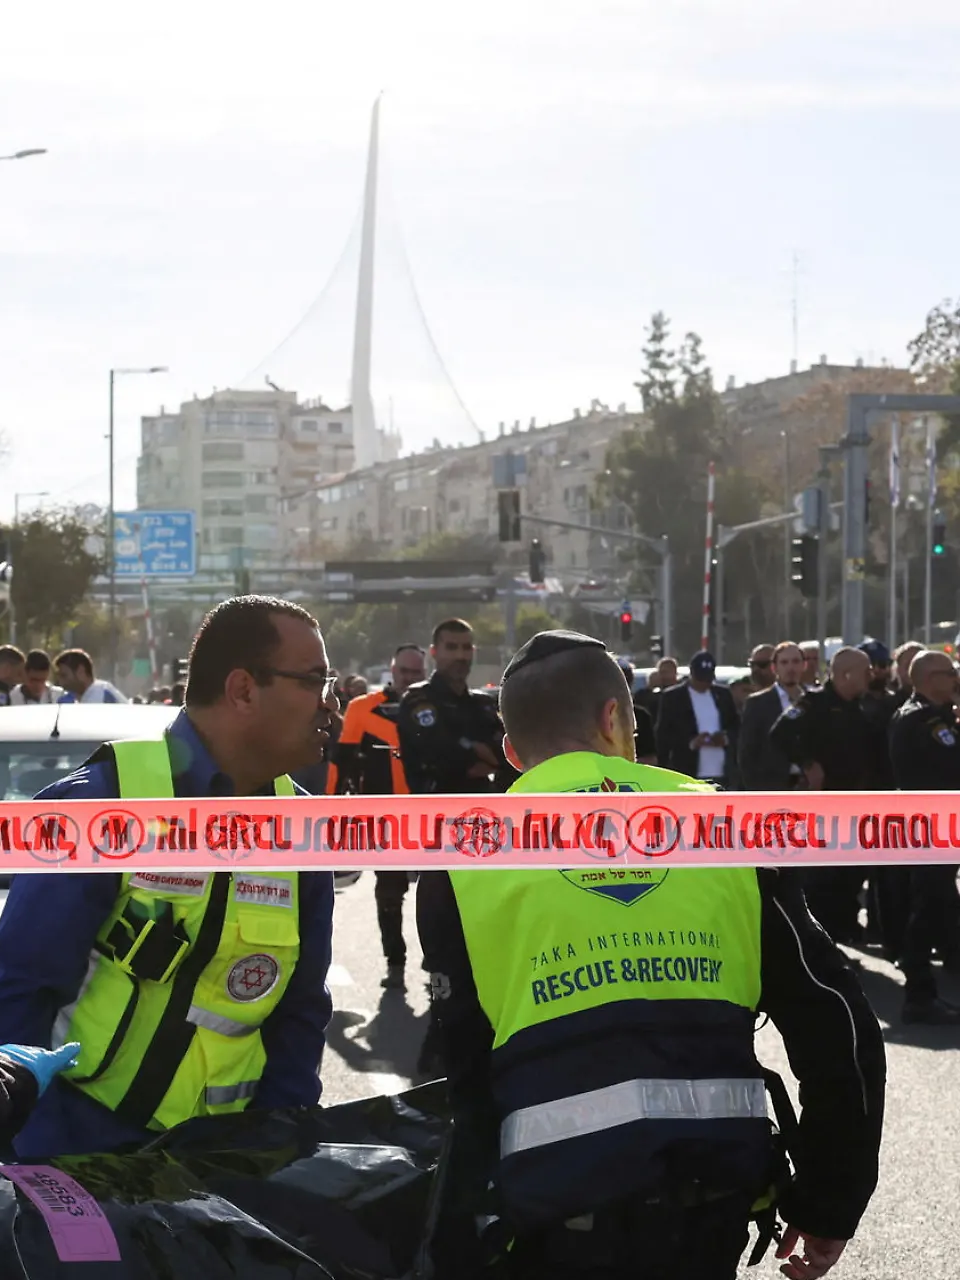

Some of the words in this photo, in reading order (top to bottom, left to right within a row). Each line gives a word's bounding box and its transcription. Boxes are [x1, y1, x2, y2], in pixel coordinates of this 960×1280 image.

[326, 812, 446, 852] משטרת
[511, 812, 617, 858] ישראל
[588, 930, 721, 952] INTERNATIONAL
[531, 959, 619, 1005] RESCUE
